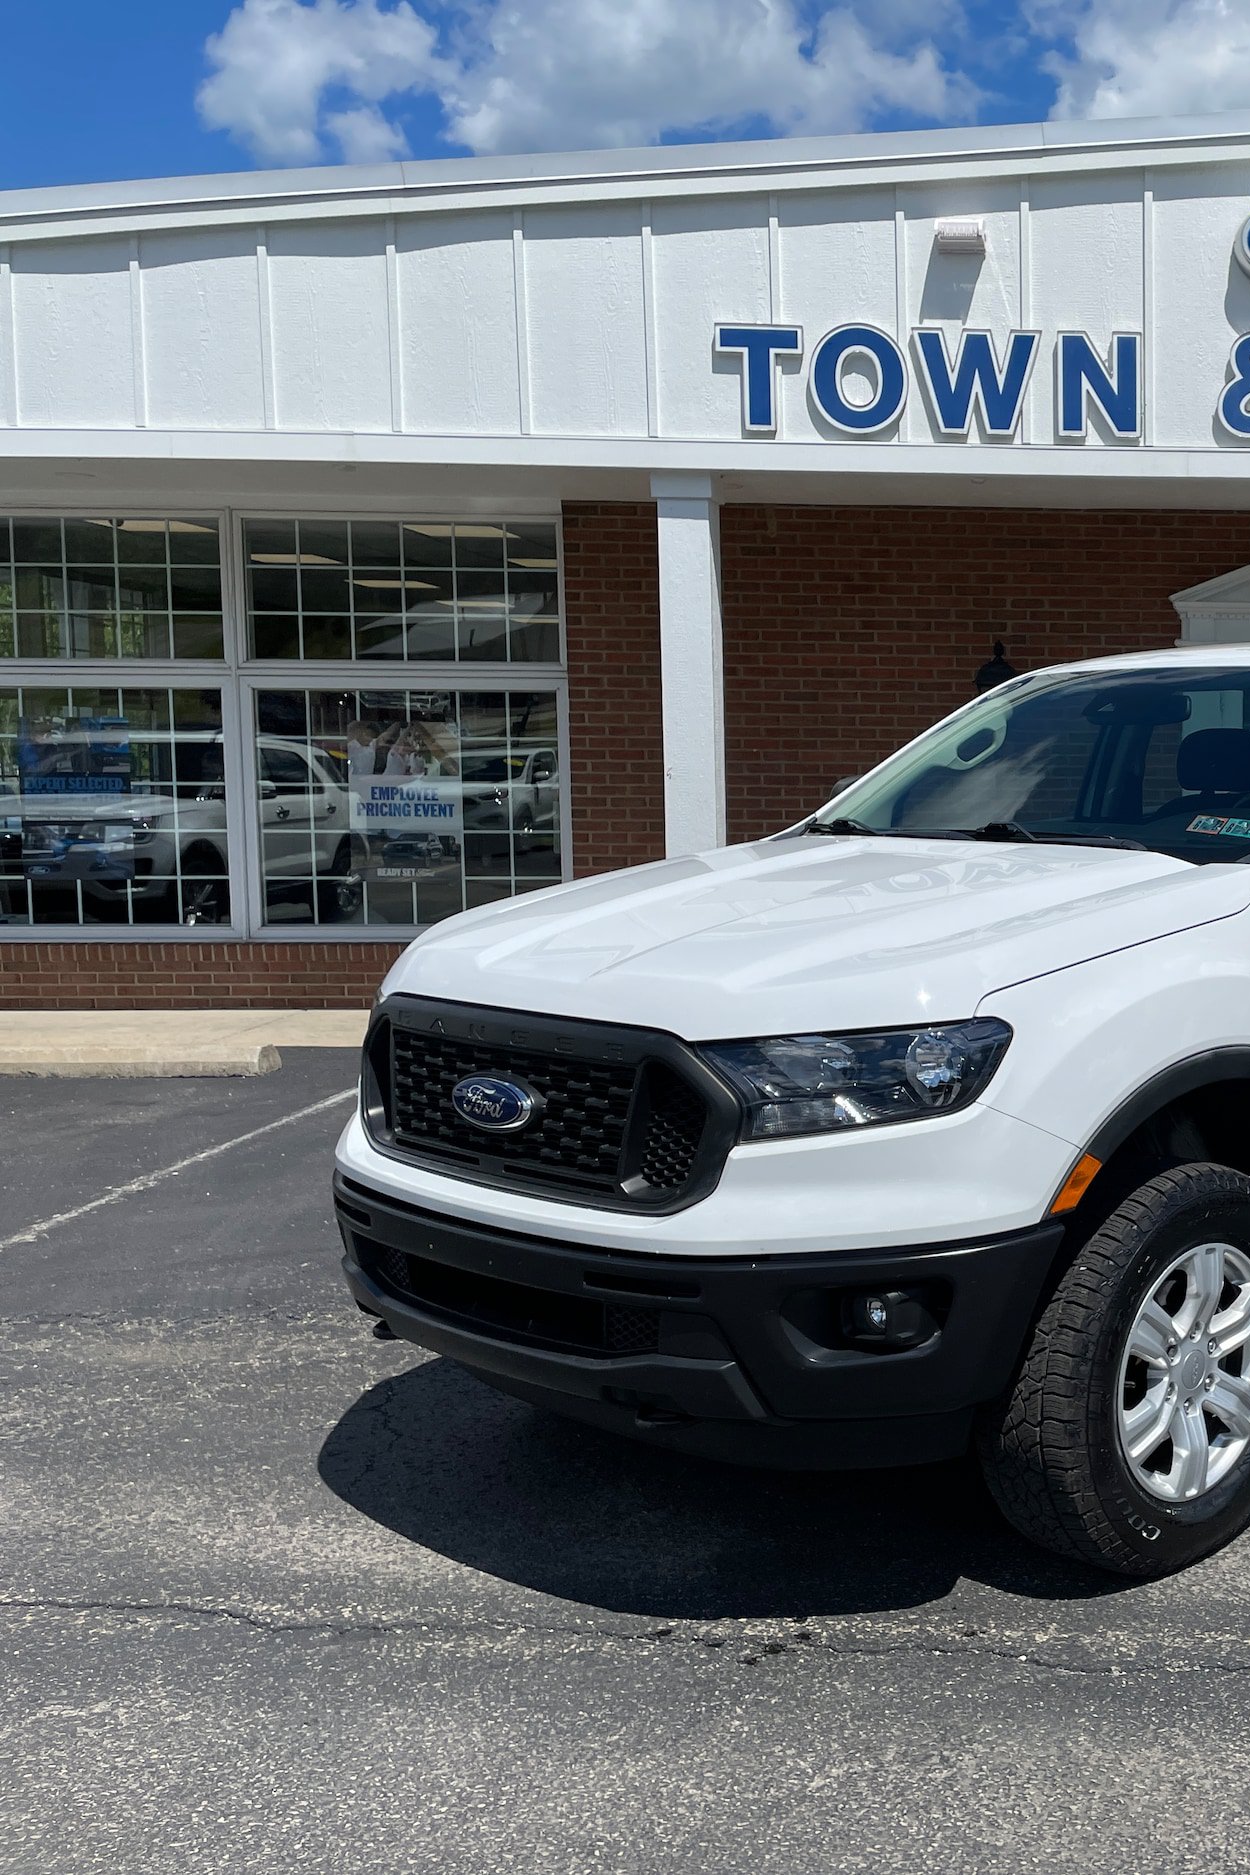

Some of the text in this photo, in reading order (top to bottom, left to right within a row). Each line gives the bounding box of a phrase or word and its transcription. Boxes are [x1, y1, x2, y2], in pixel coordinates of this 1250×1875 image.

[714, 323, 1143, 438] TOWN
[23, 776, 66, 790] EXPERT
[370, 786, 440, 801] EMPLOYEE
[356, 802, 455, 818] PRICING EVENT
[377, 867, 401, 877] READY
[401, 867, 417, 877] SET
[462, 1084, 506, 1118] Ford
